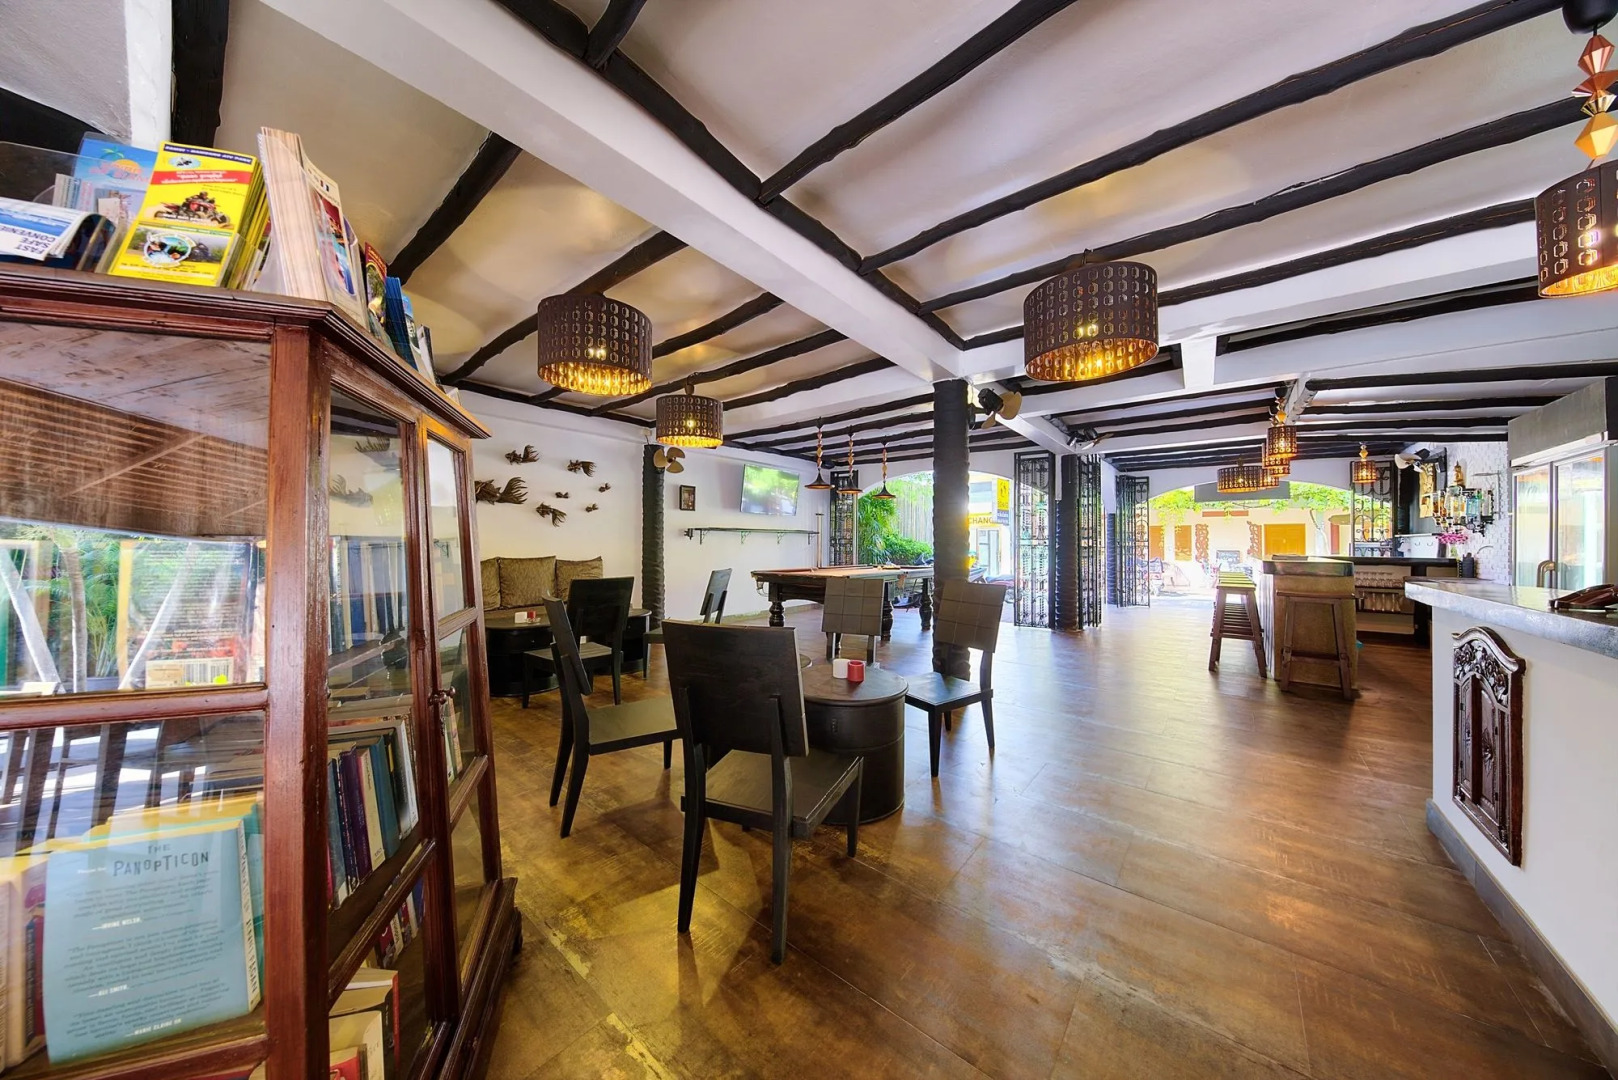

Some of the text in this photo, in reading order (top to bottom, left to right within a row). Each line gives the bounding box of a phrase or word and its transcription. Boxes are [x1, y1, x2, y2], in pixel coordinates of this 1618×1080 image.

[19, 238, 51, 248] SAFE
[14, 244, 45, 255] FAST
[148, 844, 171, 854] THE
[113, 851, 209, 877] PANOPTICON
